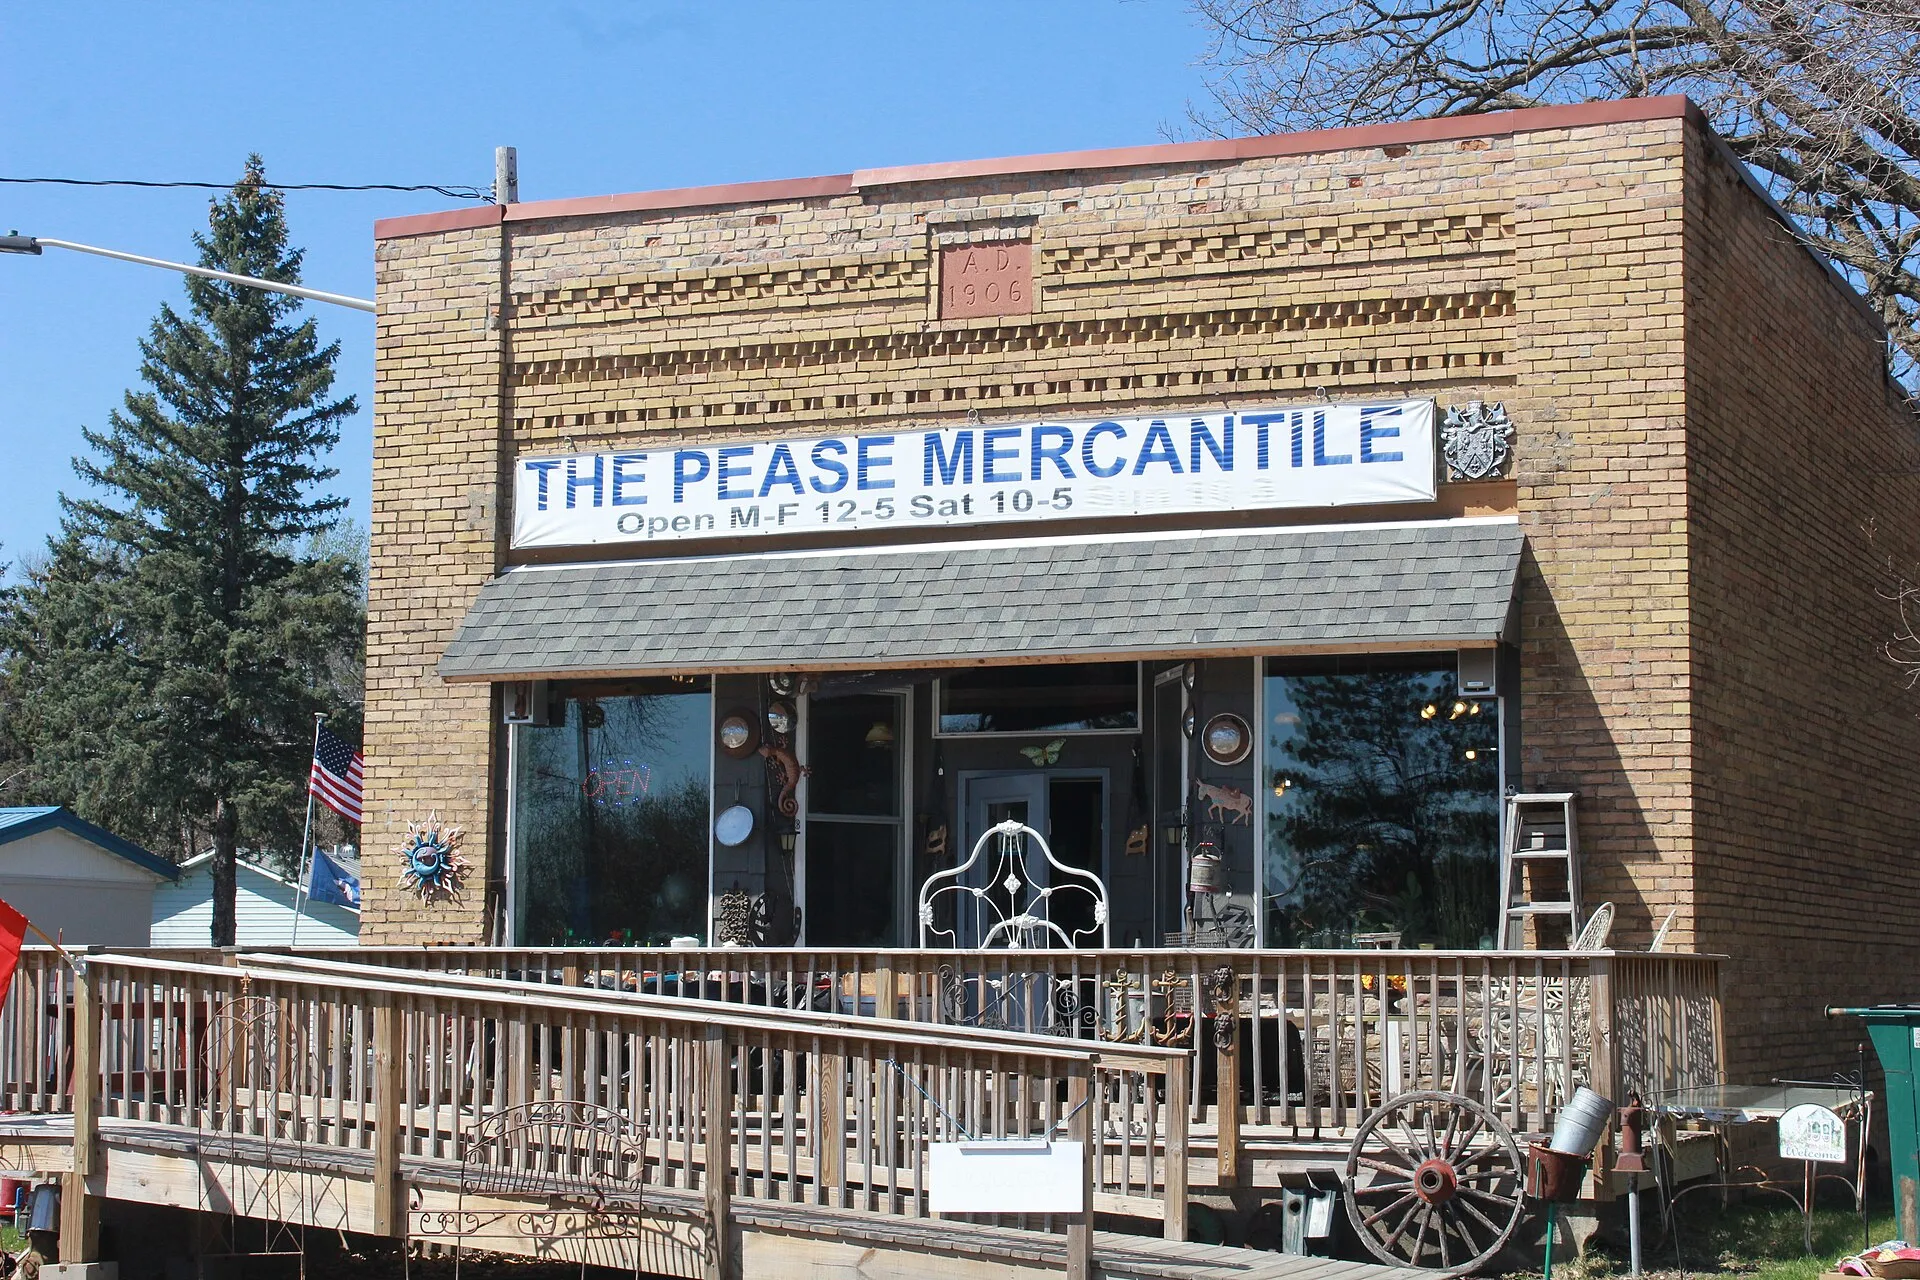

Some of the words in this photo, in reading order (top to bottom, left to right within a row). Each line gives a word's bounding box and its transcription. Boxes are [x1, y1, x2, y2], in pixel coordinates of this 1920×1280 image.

[949, 280, 1022, 308] 1906
[525, 453, 648, 511] THE
[673, 435, 896, 503] PEASE
[922, 407, 1404, 487] MERCANTILE
[616, 511, 715, 539] Open
[729, 502, 800, 529] M-F
[815, 496, 896, 523] 12-5
[908, 492, 974, 518] Sat
[989, 487, 1074, 514] 10-5
[582, 768, 651, 797] OPEN
[1785, 1146, 1841, 1160] Welcome
